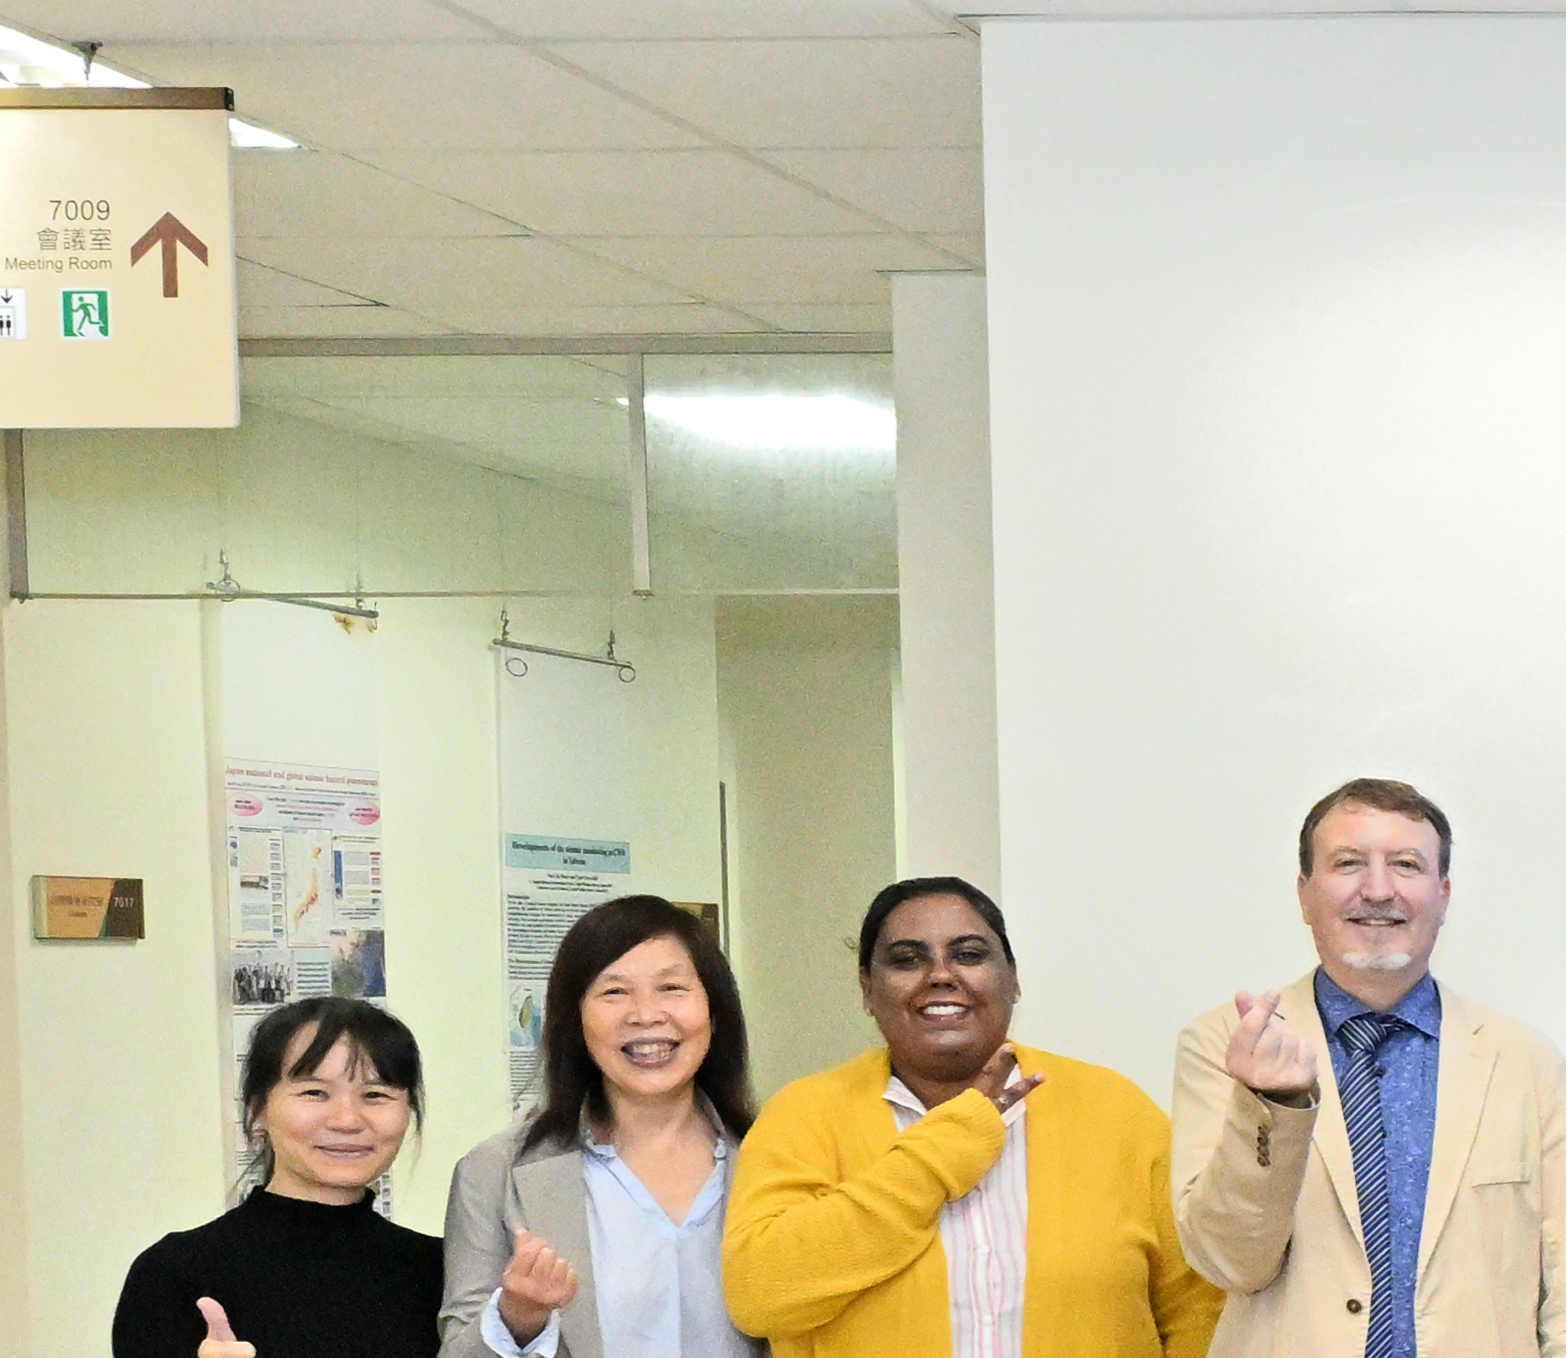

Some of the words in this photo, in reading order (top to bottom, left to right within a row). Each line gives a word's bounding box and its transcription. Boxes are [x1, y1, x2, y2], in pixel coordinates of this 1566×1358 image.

[49, 200, 110, 221] 7009
[37, 227, 112, 251] 會議室
[5, 257, 63, 273] Meeting
[68, 257, 112, 270] Room
